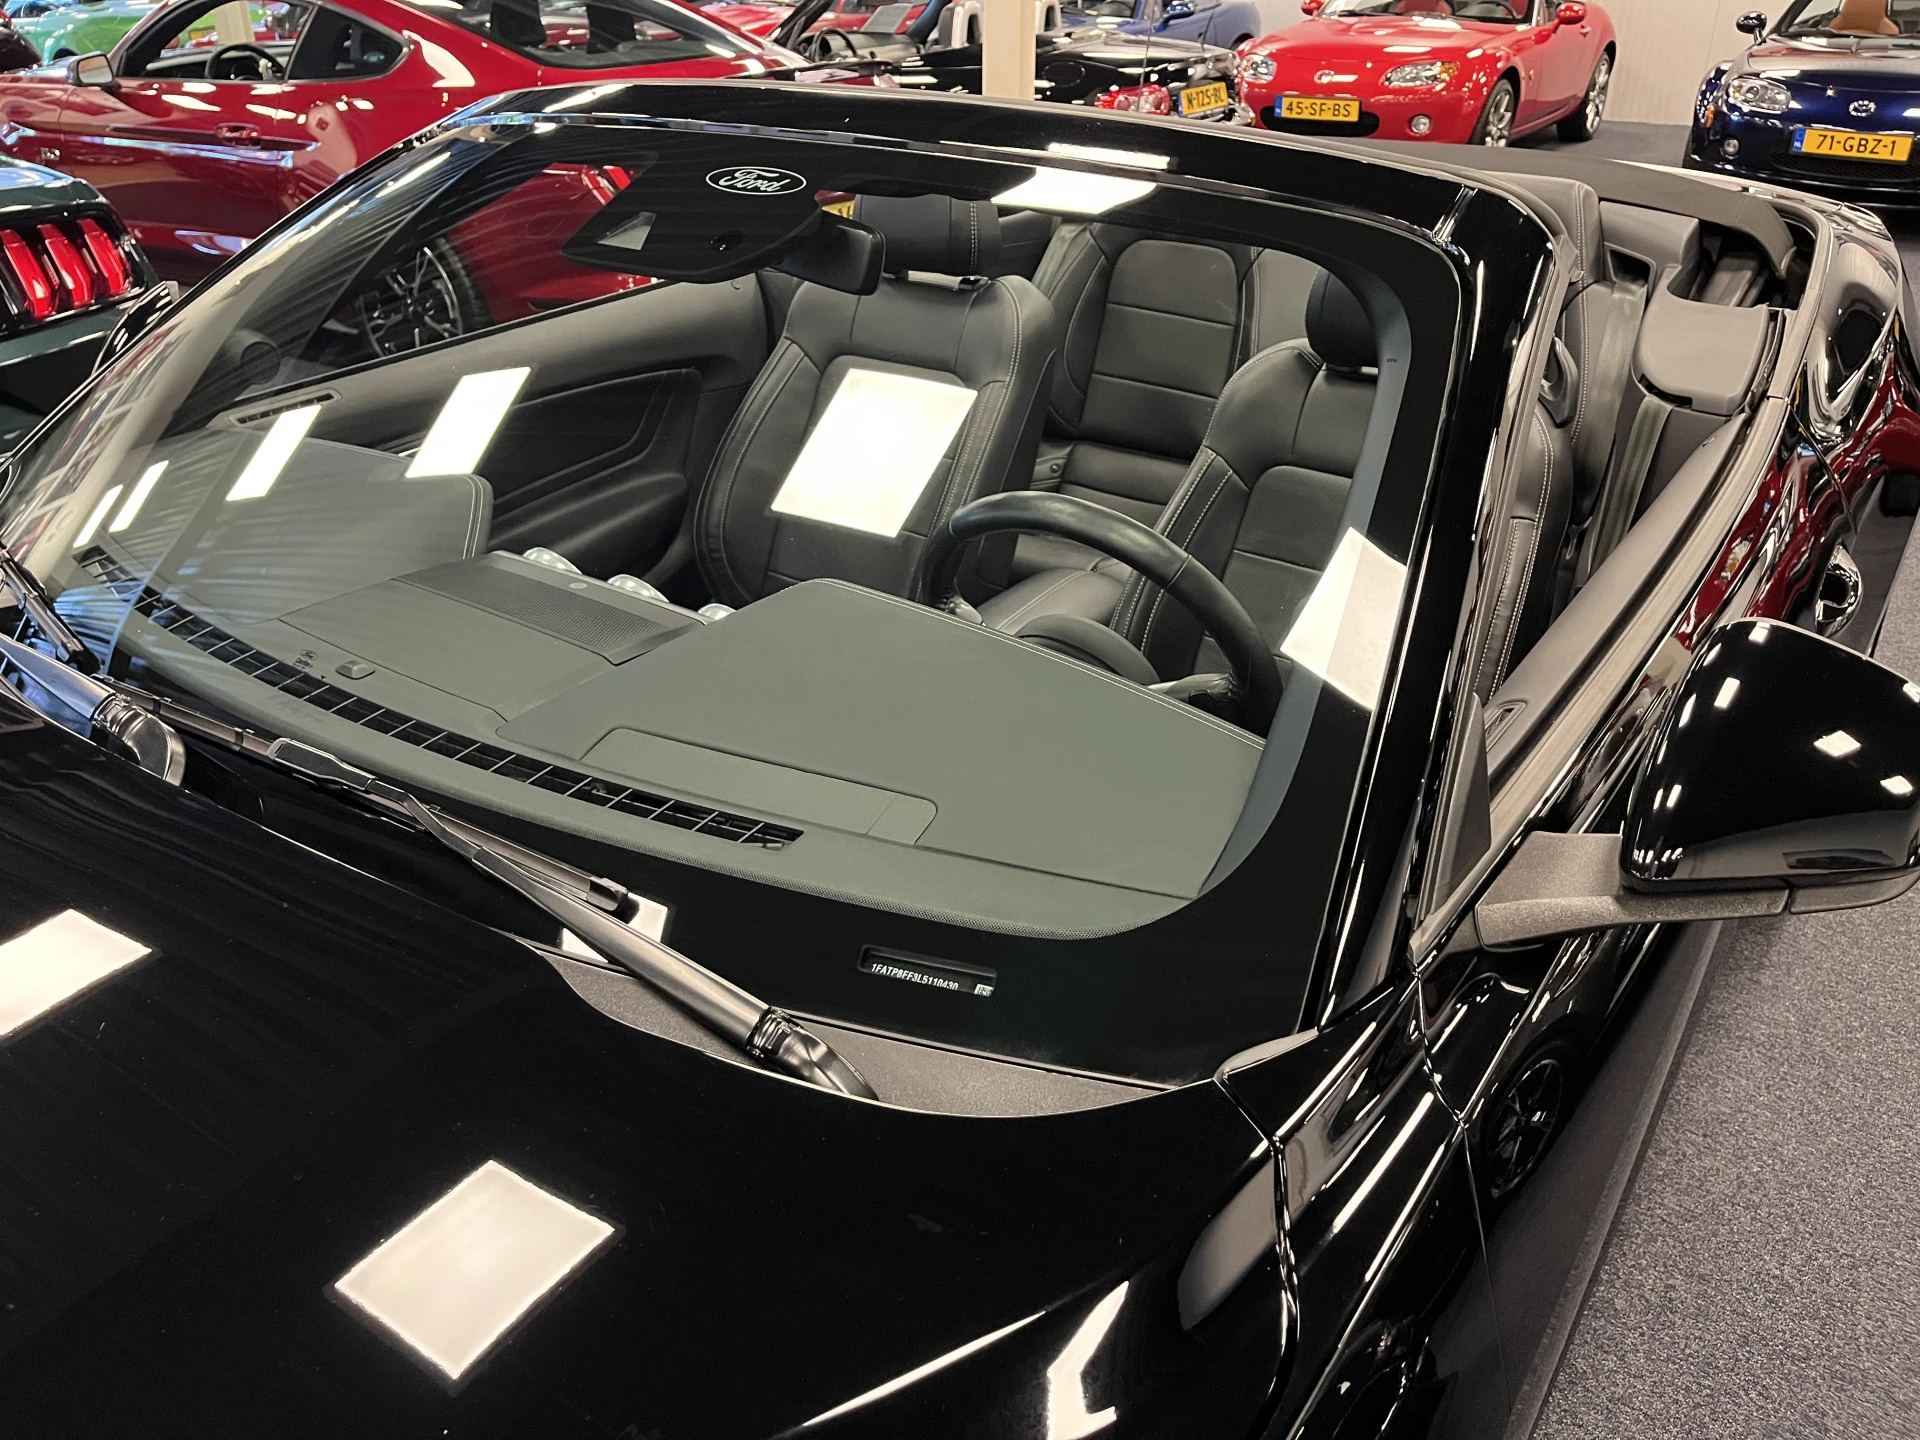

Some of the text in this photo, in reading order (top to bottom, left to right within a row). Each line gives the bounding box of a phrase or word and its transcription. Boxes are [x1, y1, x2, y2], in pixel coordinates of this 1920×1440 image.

[1186, 86, 1225, 110] N-125-BL
[1286, 101, 1351, 118] 45-SF-BS
[1816, 134, 1897, 156] 71-GBZ-1
[718, 169, 791, 192] Ford
[871, 963, 959, 990] 1FATP8FF3L5110430
